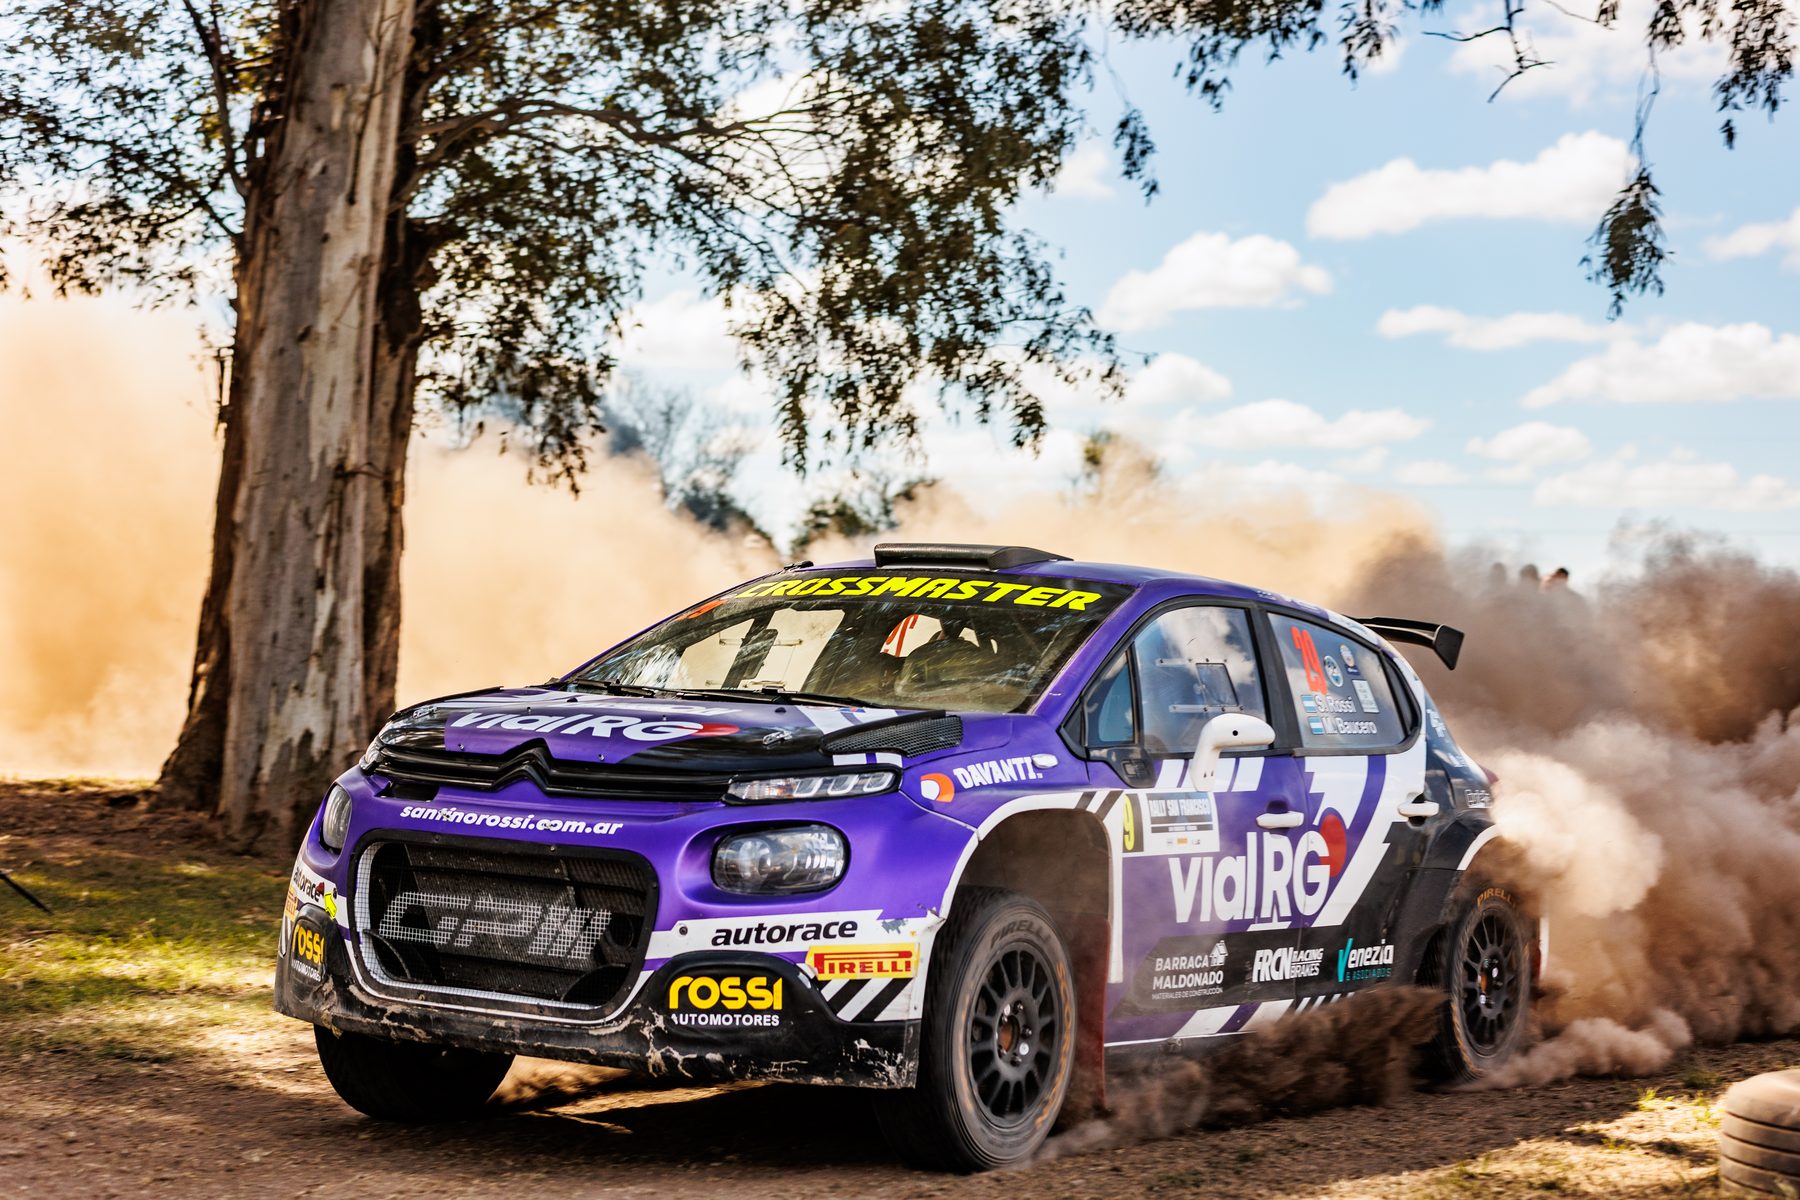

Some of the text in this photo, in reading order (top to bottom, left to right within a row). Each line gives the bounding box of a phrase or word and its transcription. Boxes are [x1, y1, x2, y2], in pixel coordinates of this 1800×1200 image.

[736, 576, 1102, 611] CROSSMASTER
[400, 806, 623, 835] santinorossi.com.ar
[712, 920, 858, 946] autorace
[814, 951, 912, 974] PIRELLI
[1155, 955, 1209, 971] BARRACA
[1338, 938, 1395, 982] Venezia
[1152, 971, 1224, 990] MALDONADO
